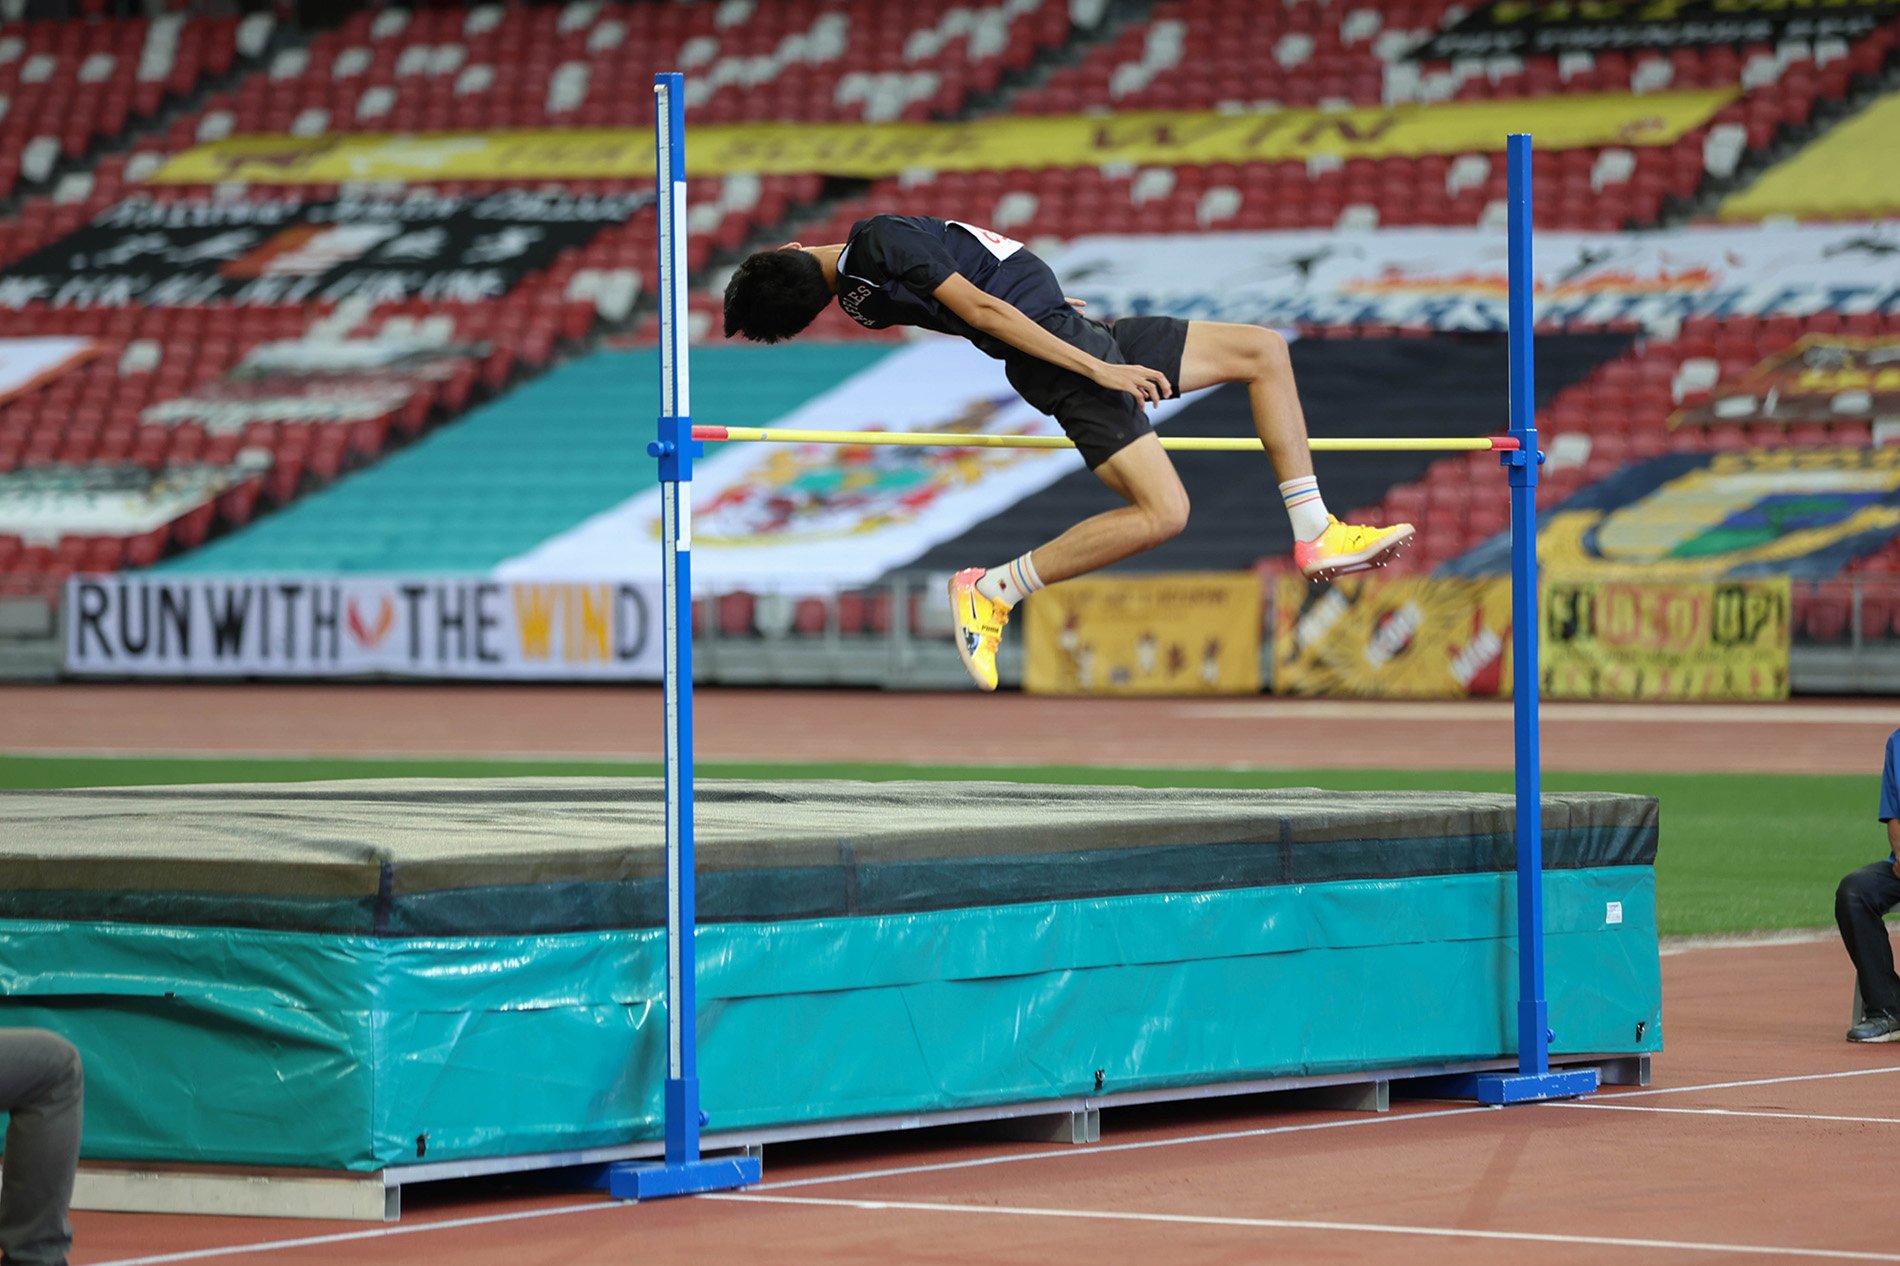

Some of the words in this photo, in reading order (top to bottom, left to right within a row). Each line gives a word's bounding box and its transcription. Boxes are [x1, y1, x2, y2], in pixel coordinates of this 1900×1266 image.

[1091, 113, 1402, 148] WIN
[77, 583, 191, 658] RUN
[204, 583, 340, 660] WITH
[400, 583, 503, 662] THE
[512, 582, 649, 664] WIND
